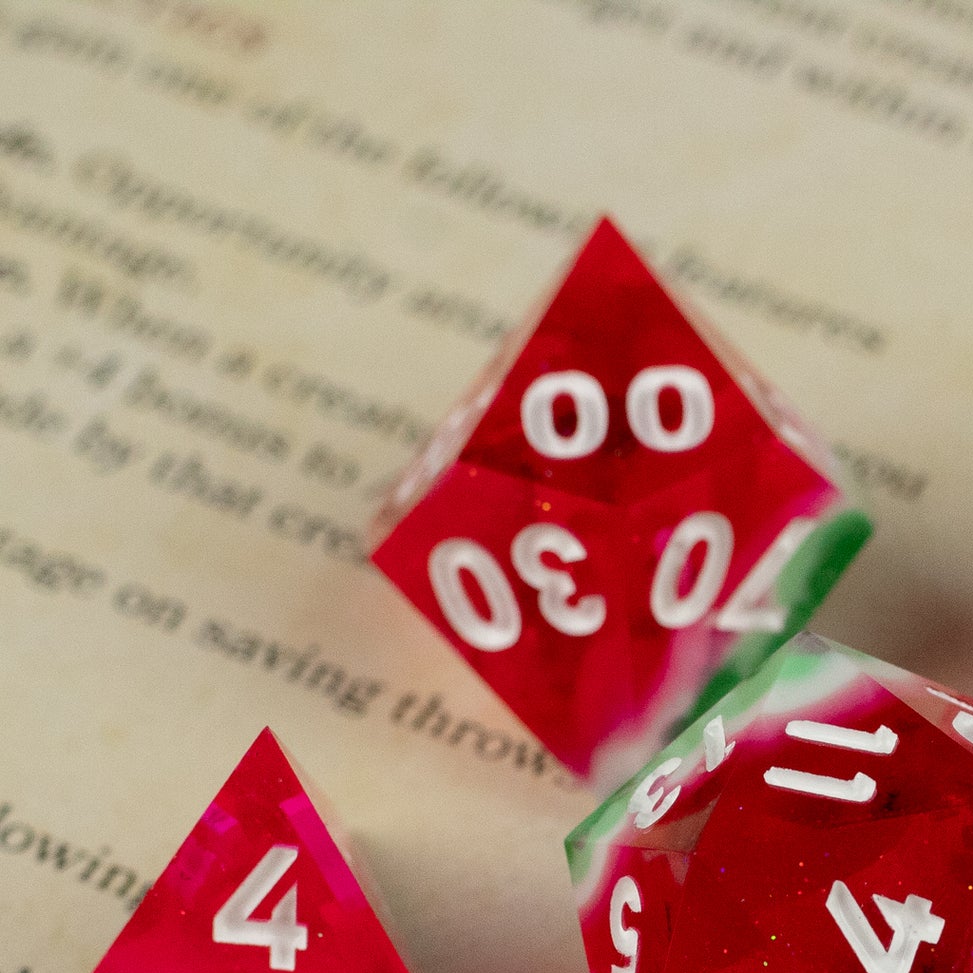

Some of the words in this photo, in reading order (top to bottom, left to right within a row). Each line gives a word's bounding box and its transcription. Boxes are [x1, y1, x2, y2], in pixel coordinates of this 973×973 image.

[521, 364, 715, 460] 00
[763, 719, 899, 803] 11
[213, 844, 308, 972] 4
